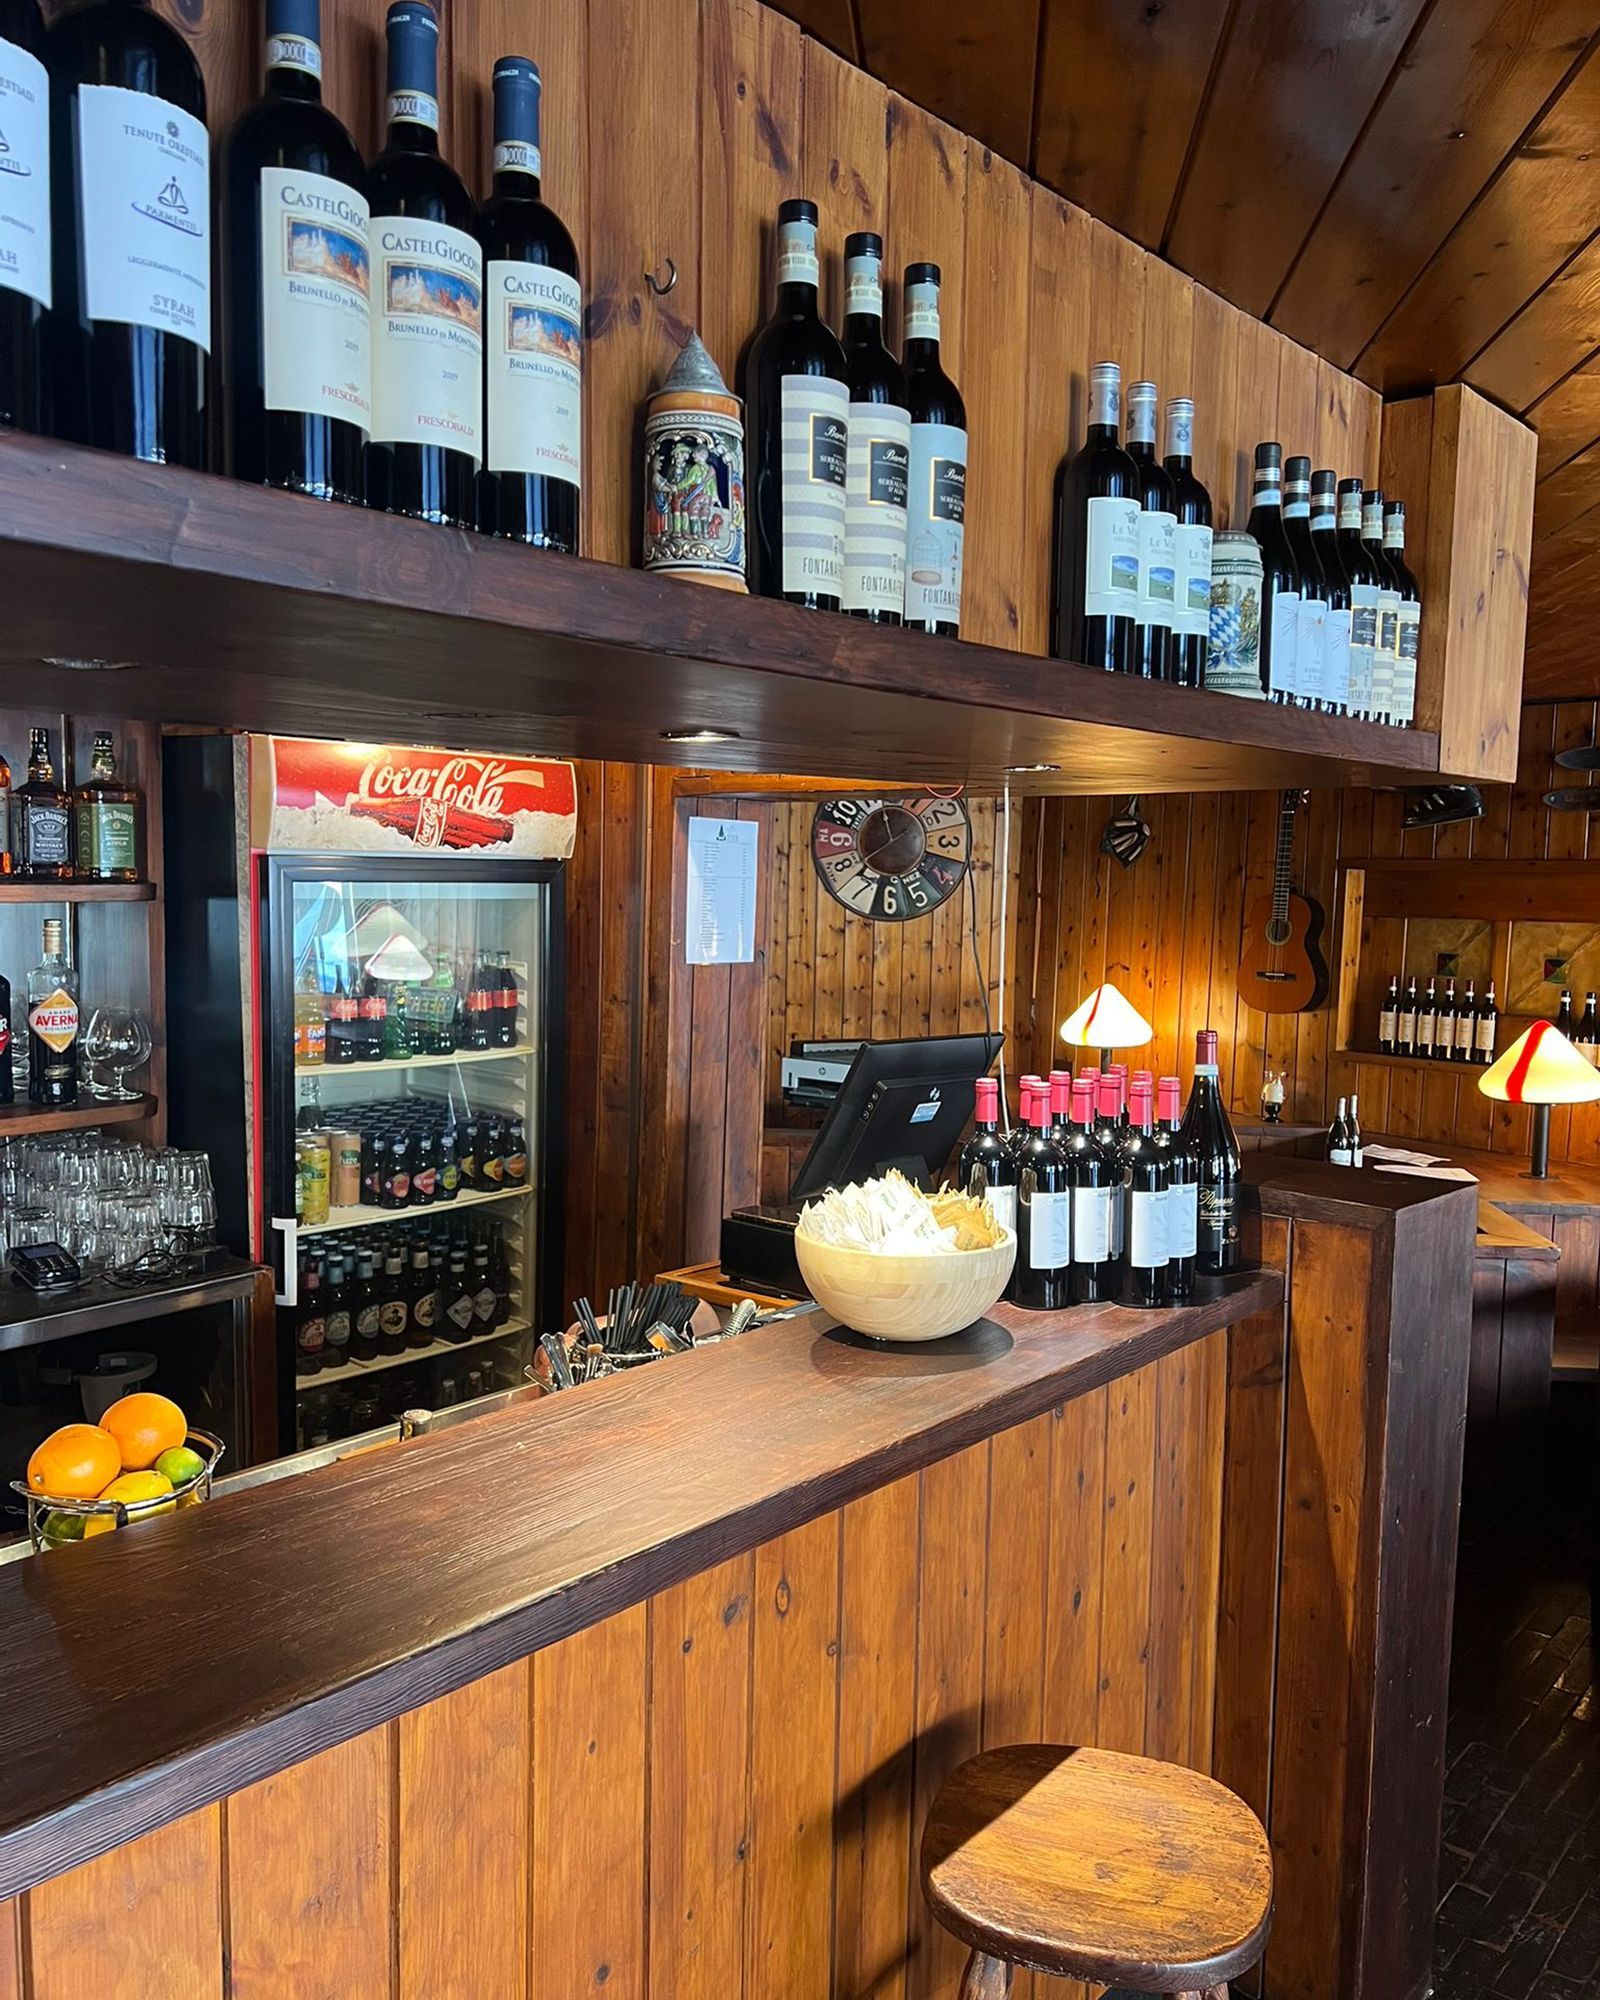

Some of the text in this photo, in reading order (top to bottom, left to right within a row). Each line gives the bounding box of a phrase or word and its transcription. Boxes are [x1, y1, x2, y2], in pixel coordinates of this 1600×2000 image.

[122, 123, 165, 145] TENUTE
[288, 281, 342, 303] BRUNELLO
[152, 294, 195, 319] SYRAH
[388, 320, 439, 337] BRUNELLO
[508, 357, 554, 374] BRUNELLO
[357, 753, 506, 817] Coca-Cola
[30, 813, 45, 825] JACK
[931, 802, 957, 824] 2
[830, 832, 853, 847] 9
[938, 834, 960, 849] 3
[834, 858, 852, 872] 8
[852, 876, 872, 900] 7
[907, 881, 928, 907] 5
[883, 885, 897, 915] 6
